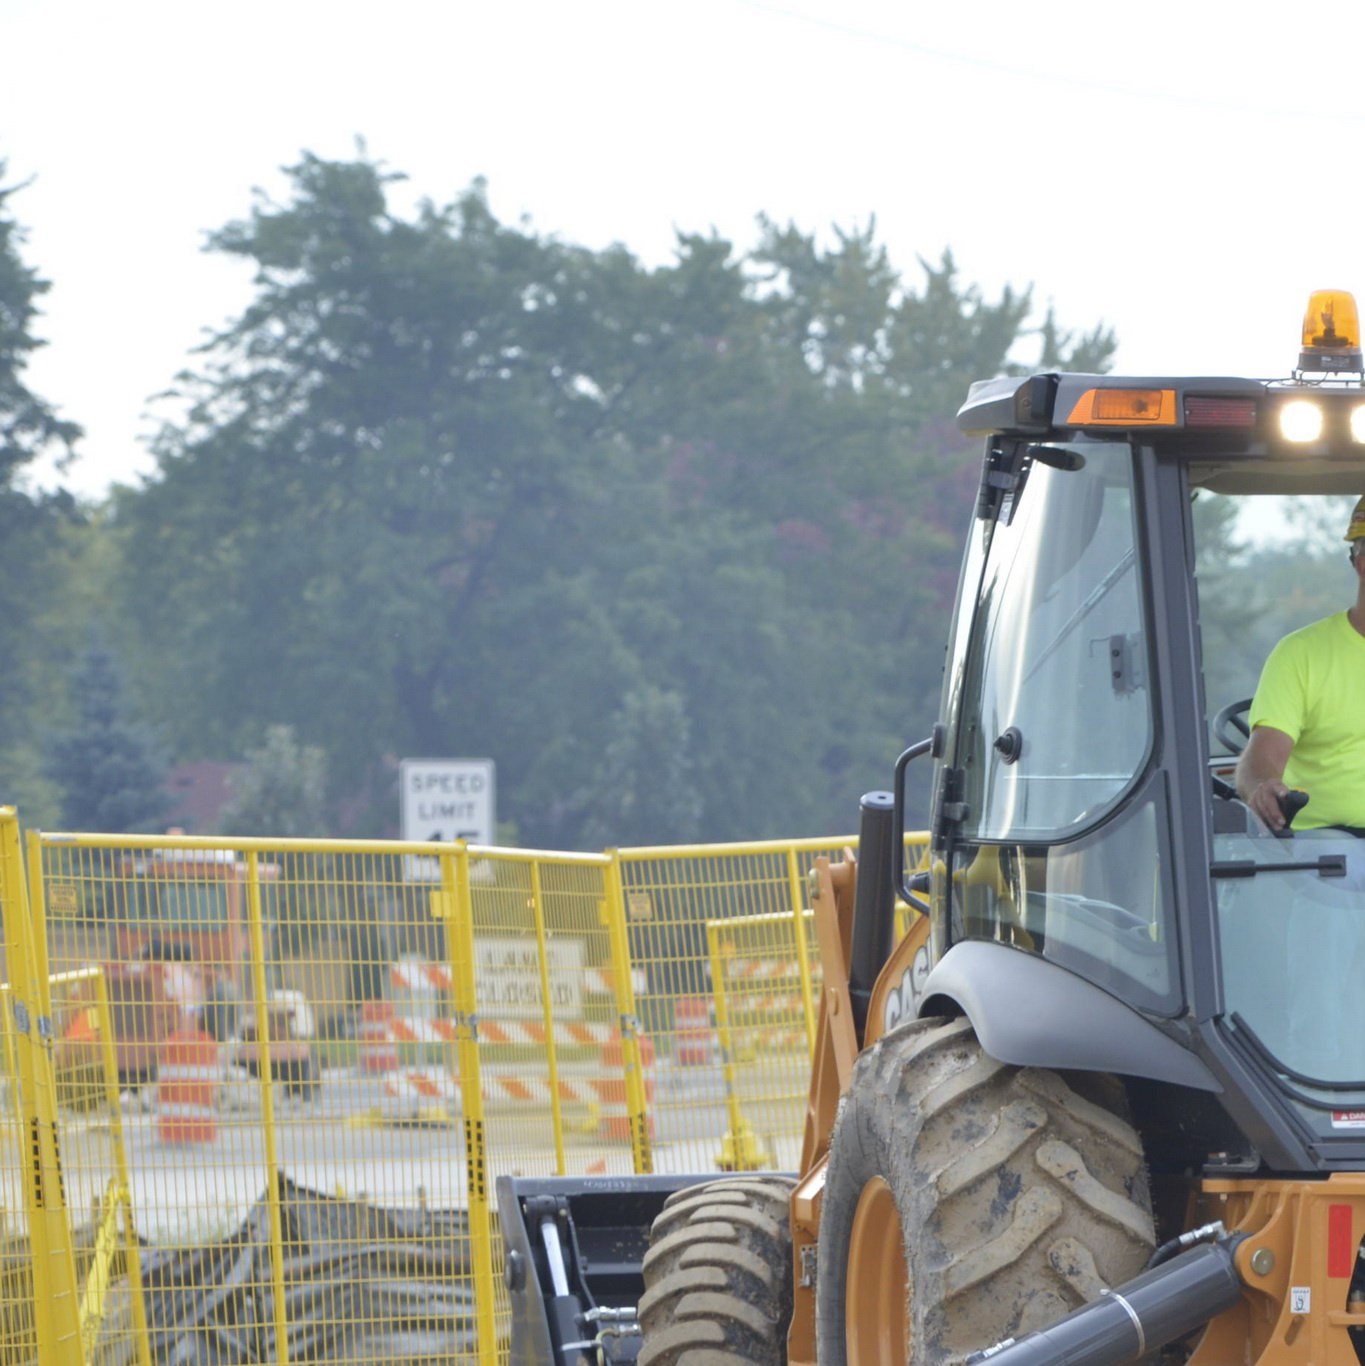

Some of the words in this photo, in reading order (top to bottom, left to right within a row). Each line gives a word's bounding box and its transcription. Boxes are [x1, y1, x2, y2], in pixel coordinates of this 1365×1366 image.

[410, 773, 487, 794] SPEED
[418, 801, 476, 821] LIMIT
[885, 935, 931, 1032] CAS
